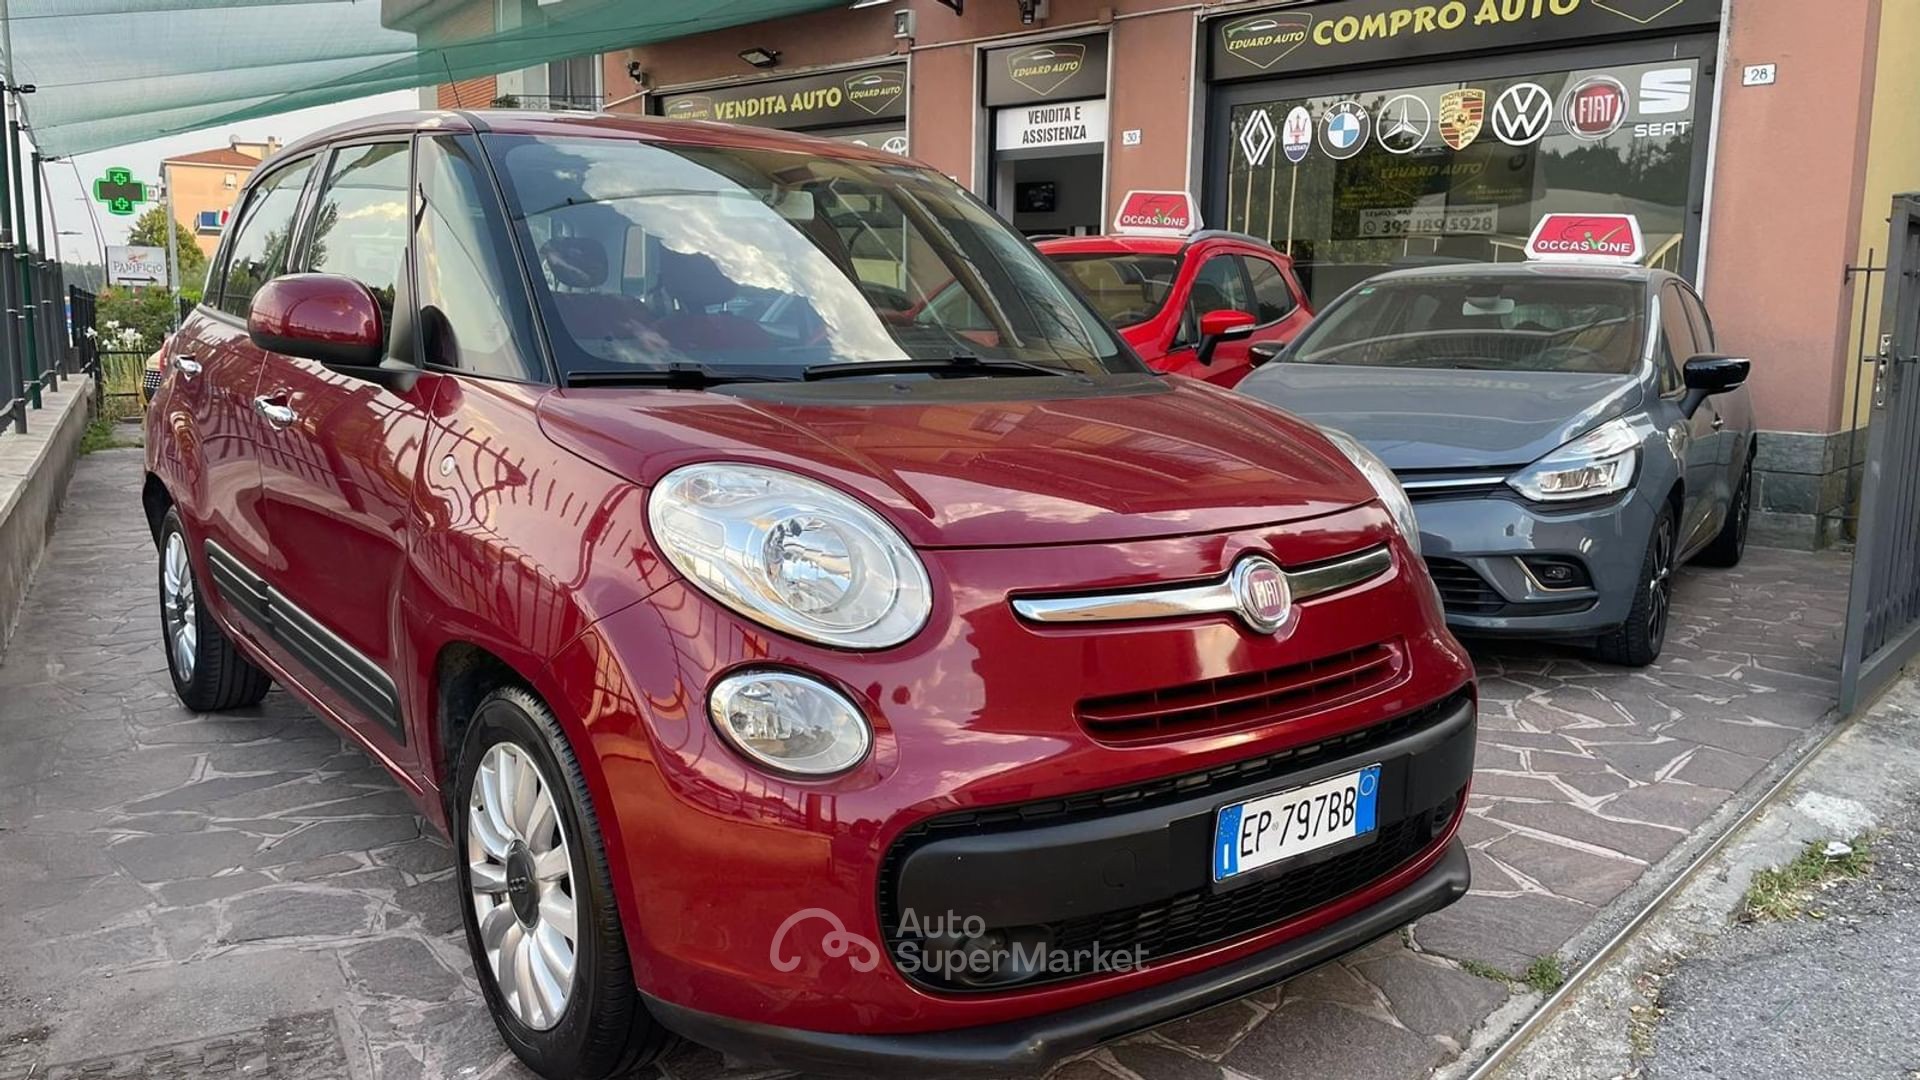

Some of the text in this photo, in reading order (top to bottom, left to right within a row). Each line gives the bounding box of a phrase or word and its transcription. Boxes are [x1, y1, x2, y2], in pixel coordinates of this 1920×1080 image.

[1312, 0, 1581, 45] COMPRO AUTO
[1229, 31, 1304, 50] EDUARD AUTO
[1013, 61, 1079, 78] EDUARD AUTO
[1751, 68, 1768, 81] 28
[880, 86, 901, 96] AUTO
[715, 86, 842, 120] VENDITA AUTO
[1324, 102, 1366, 123] BMW
[1579, 94, 1615, 124] FIAT
[1028, 106, 1081, 125] VENDITA E
[1022, 125, 1087, 145] ASSISTENZA
[1634, 121, 1691, 138] SEAT
[113, 261, 163, 274] PANIFICIO
[1253, 578, 1280, 610] FIAT
[1241, 810, 1272, 858] EP
[1279, 786, 1357, 847] 797BB
